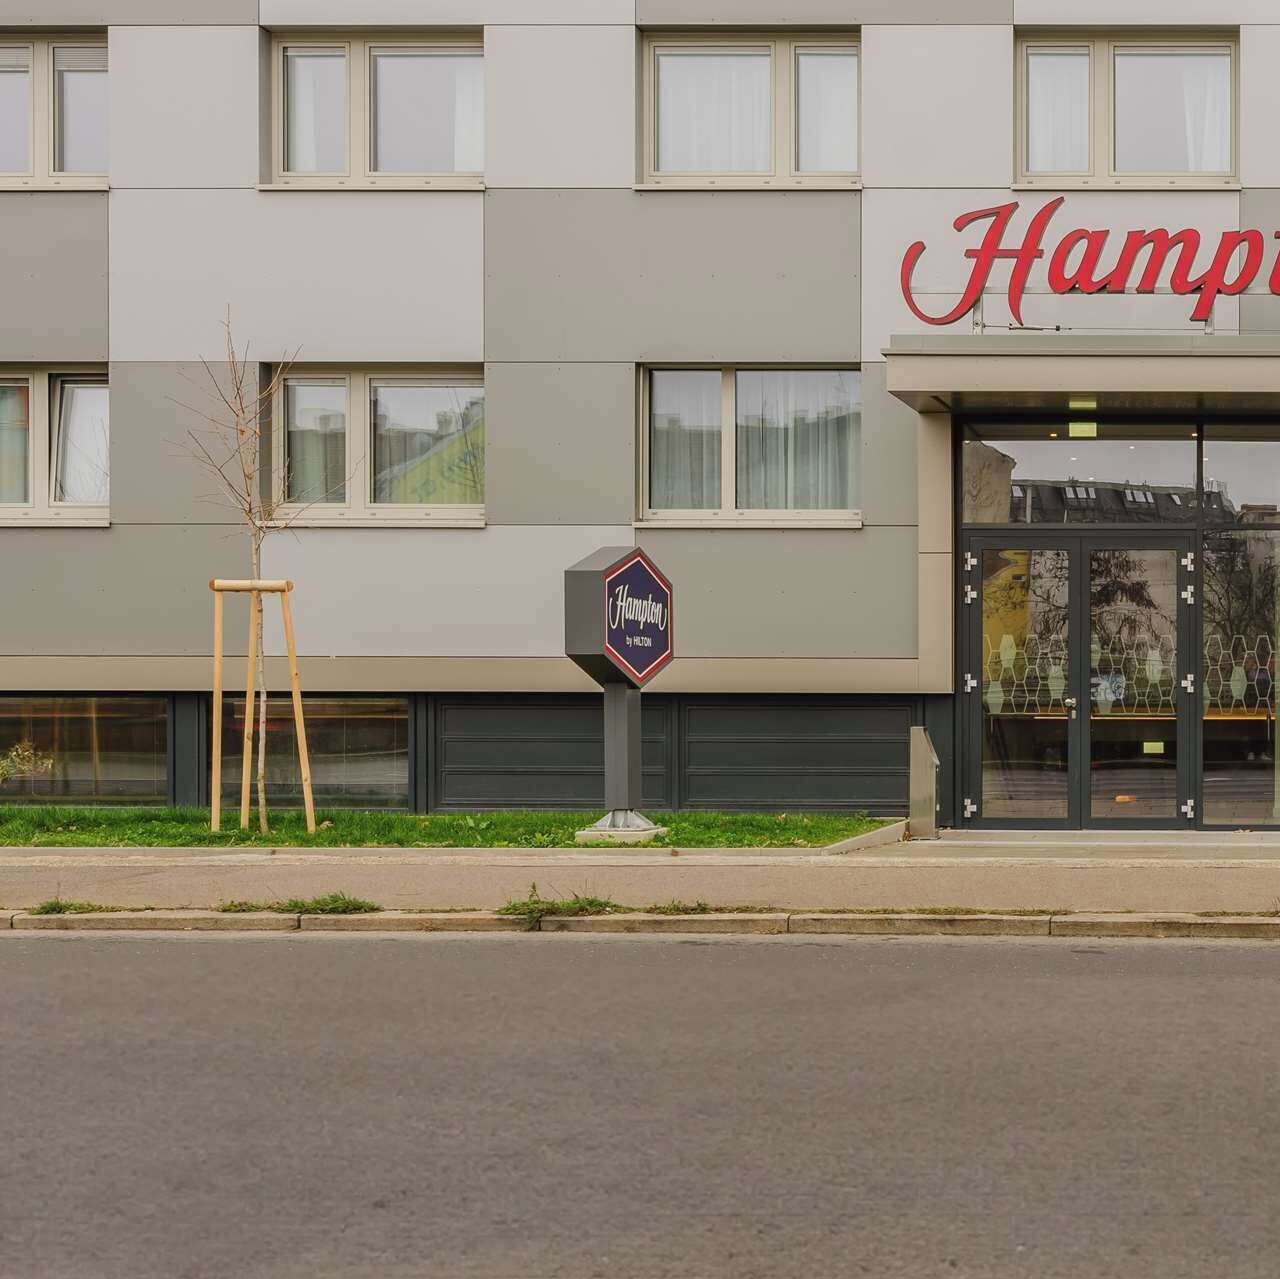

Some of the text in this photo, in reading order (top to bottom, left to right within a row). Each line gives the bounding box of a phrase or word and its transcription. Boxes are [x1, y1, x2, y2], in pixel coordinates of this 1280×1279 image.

[609, 584, 667, 630] Hampton
[626, 635, 652, 647] by HILTON
